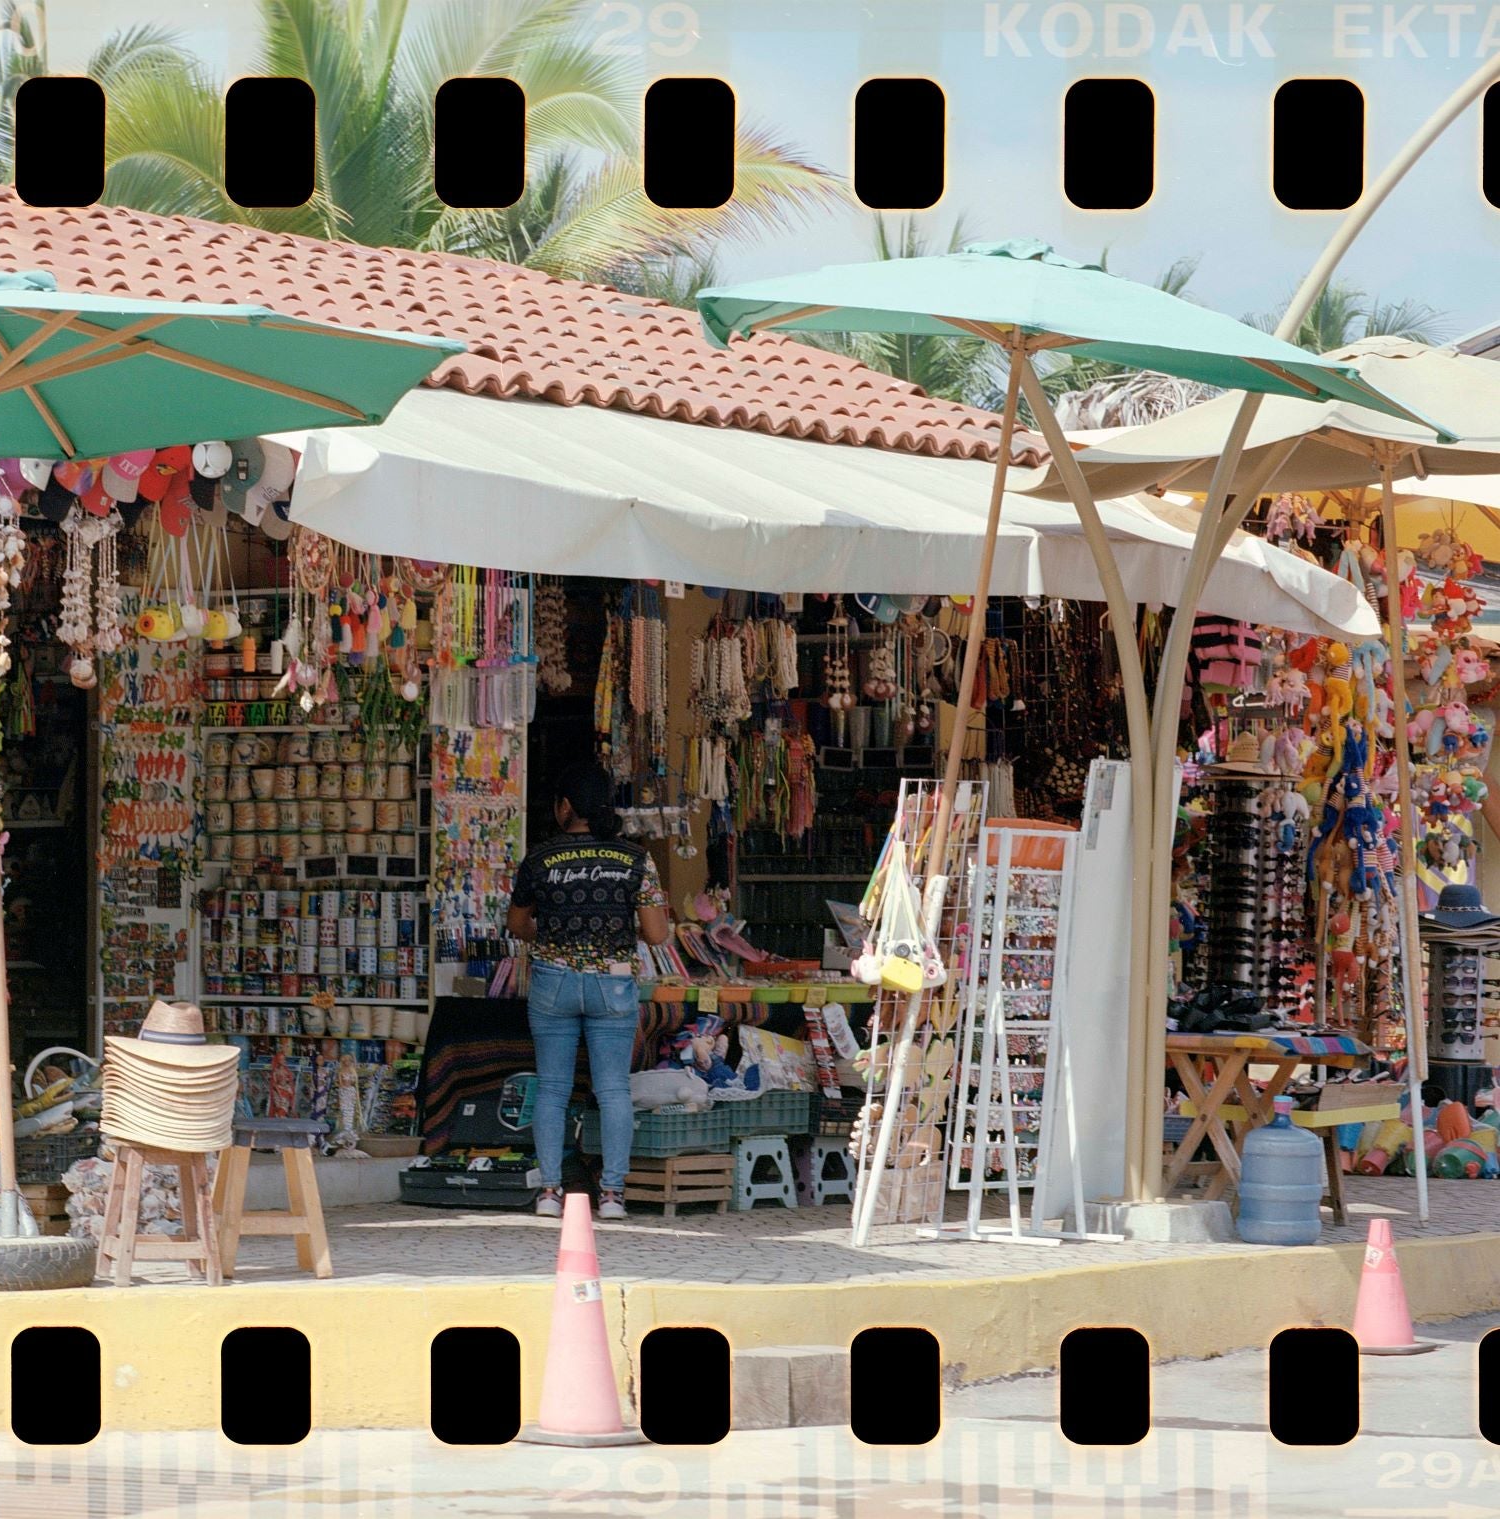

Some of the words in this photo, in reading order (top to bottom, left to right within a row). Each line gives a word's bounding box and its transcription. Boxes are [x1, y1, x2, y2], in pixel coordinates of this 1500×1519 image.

[544, 850, 580, 868] DANZA
[579, 849, 598, 858] DEL
[547, 868, 562, 884] Mi
